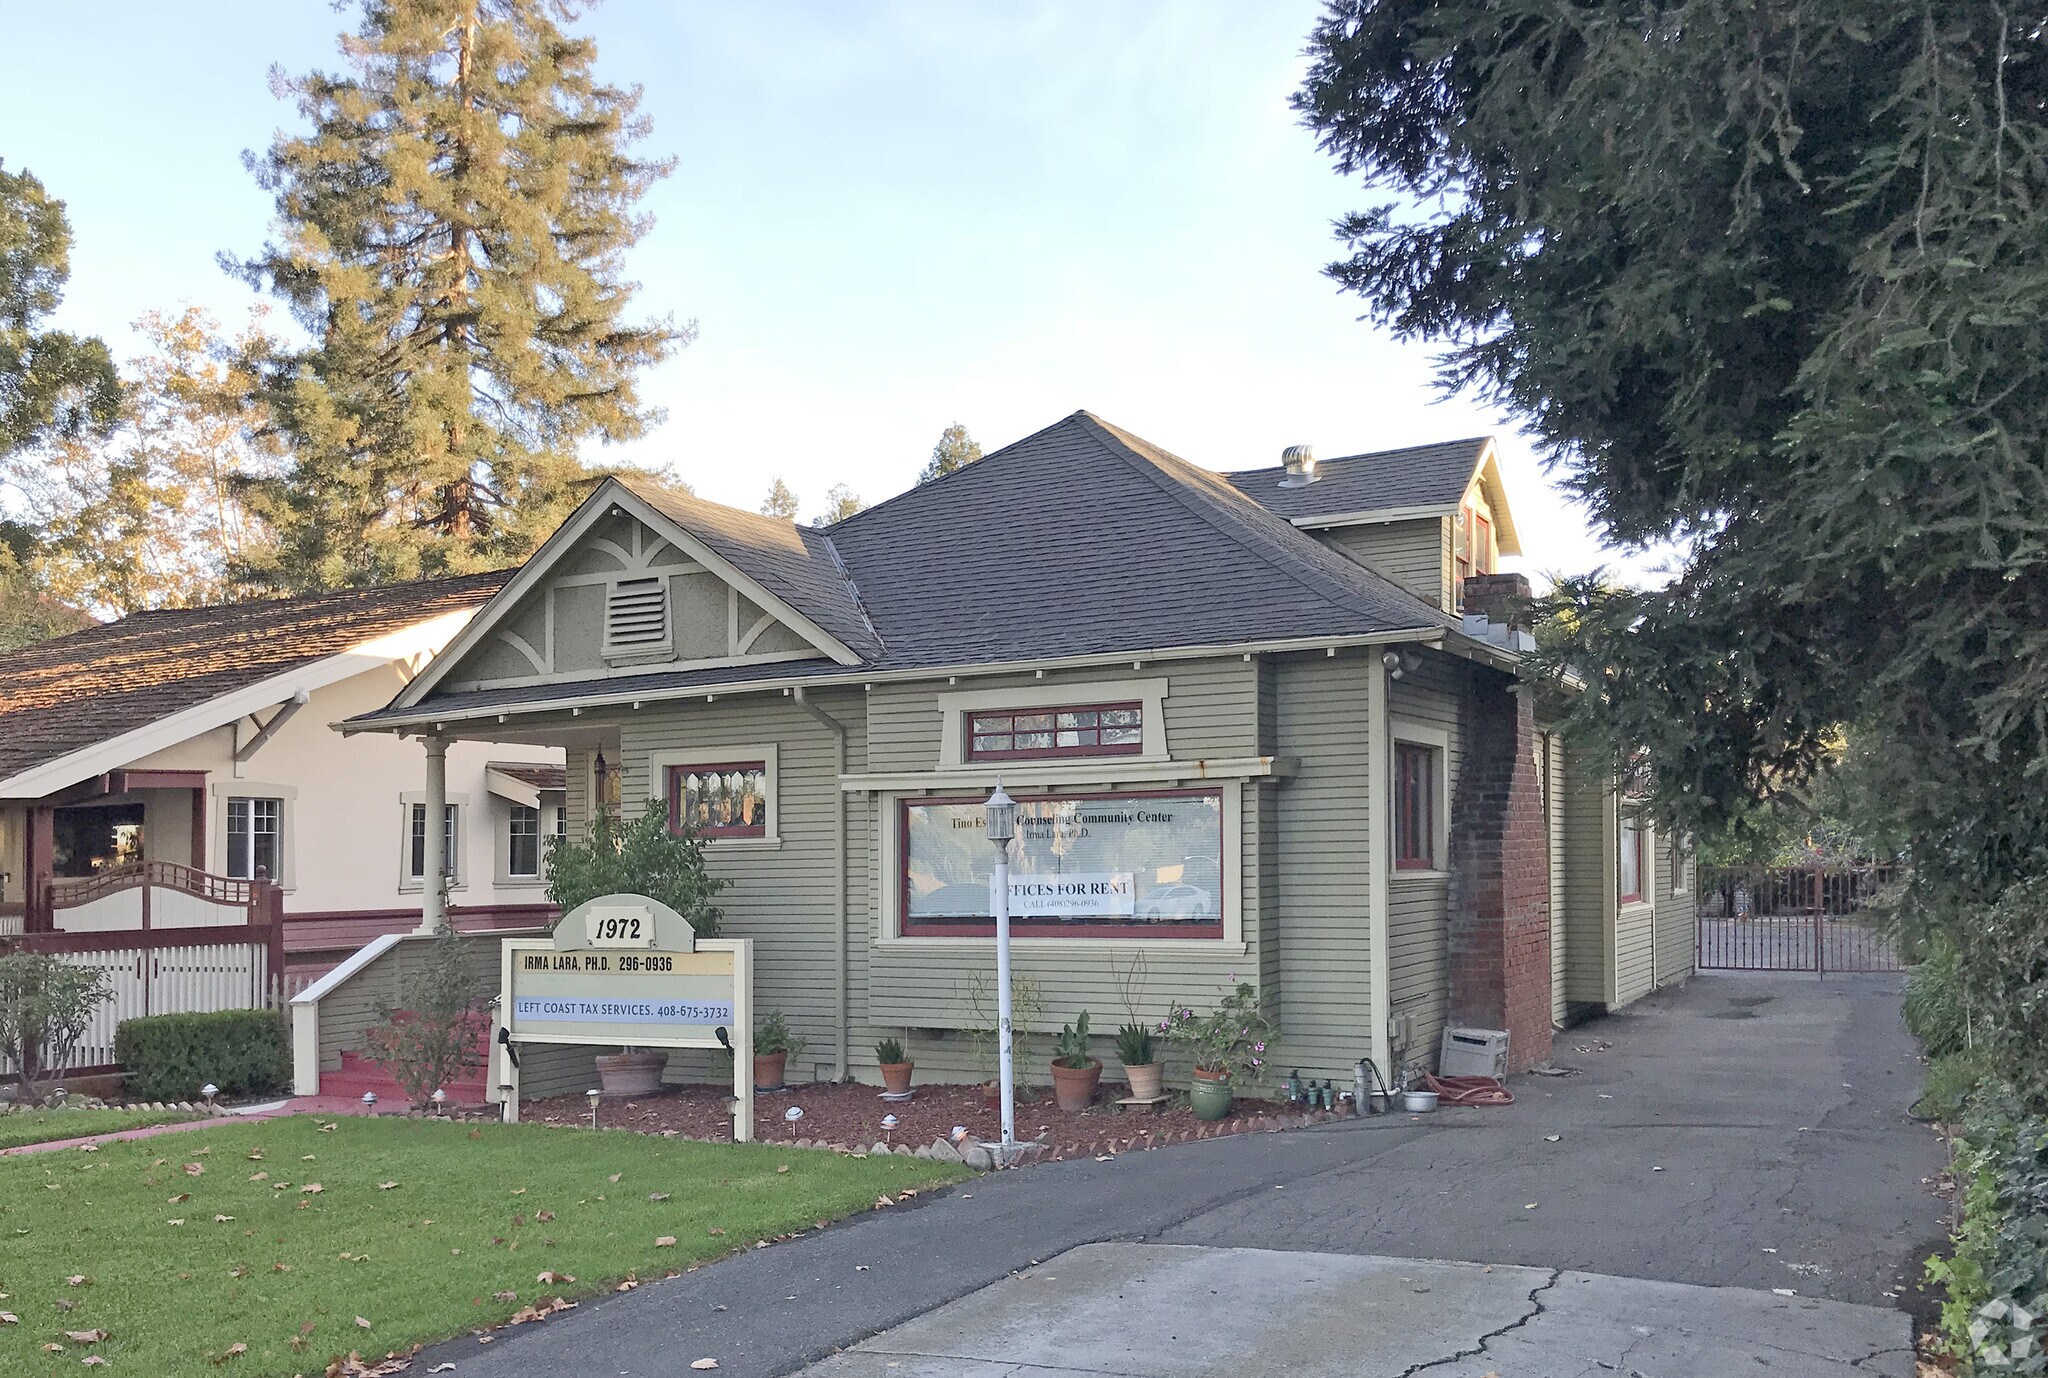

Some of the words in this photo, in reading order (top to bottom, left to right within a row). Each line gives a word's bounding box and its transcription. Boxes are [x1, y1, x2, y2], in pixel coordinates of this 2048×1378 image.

[951, 817, 973, 829] Tino
[1016, 813, 1071, 826] Counseling
[1073, 811, 1134, 826] Community
[1136, 810, 1173, 823] Center
[1025, 829, 1044, 840] Irma
[994, 883, 1054, 898] FFICES
[1057, 882, 1087, 896] FOR
[1090, 881, 1129, 895] RENT
[1023, 900, 1046, 909] CALL
[595, 918, 641, 940] 1972
[524, 955, 549, 971] IRMA
[553, 956, 582, 973] LARA,
[585, 956, 611, 971] PH.D.
[619, 956, 673, 972] 296-0936
[518, 1002, 541, 1014] LEFT
[543, 1002, 577, 1015] COAST
[579, 1003, 599, 1015] TAX
[601, 1004, 654, 1017] SERVICES.
[657, 1005, 729, 1019] 408-675-3732
